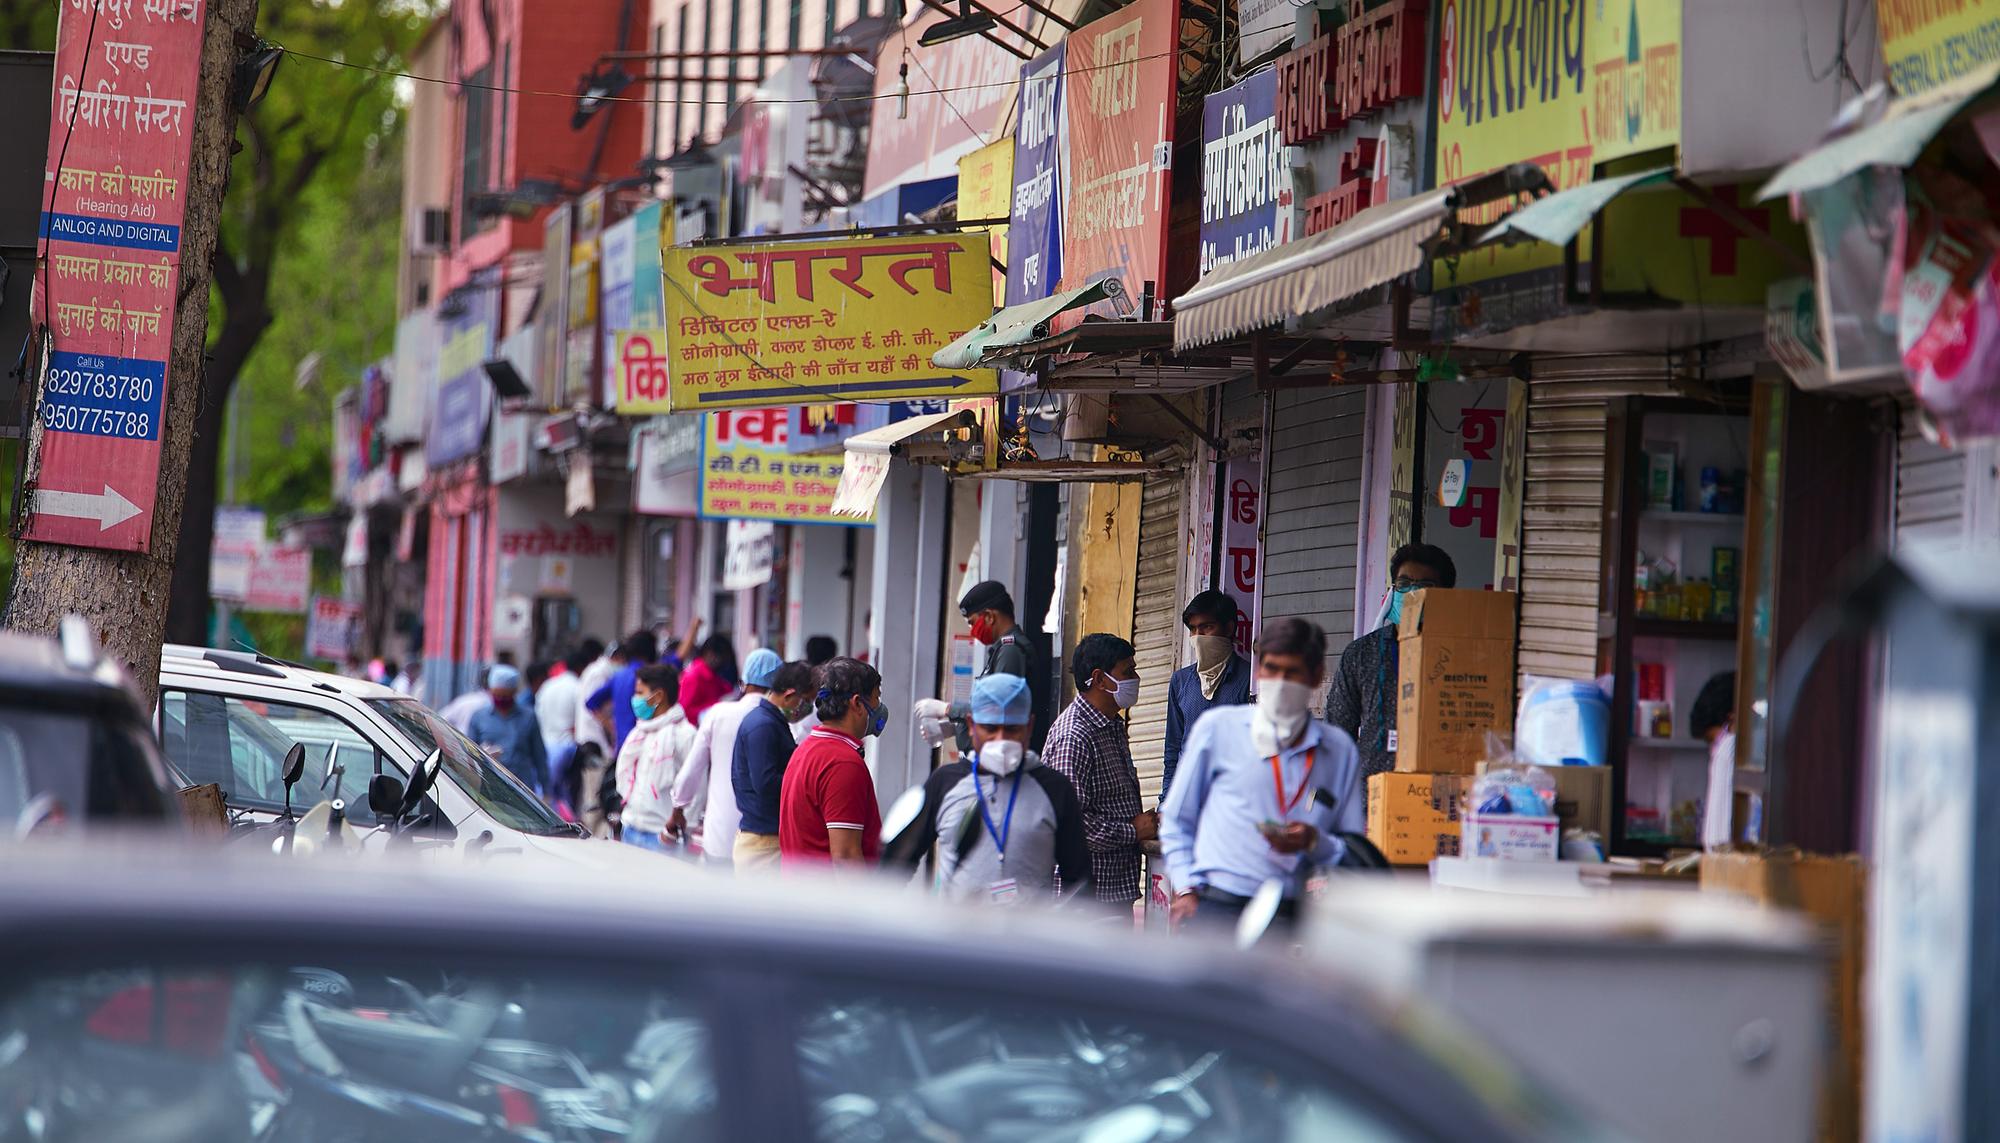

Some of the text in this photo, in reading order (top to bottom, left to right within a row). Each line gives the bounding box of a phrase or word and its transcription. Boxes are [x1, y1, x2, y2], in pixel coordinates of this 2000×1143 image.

[1089, 16, 1143, 121] भारत
[76, 196, 156, 219] (Hearing Aid)
[52, 217, 173, 243] ANLOG AND DIGITAL
[55, 254, 100, 282] समस्त
[148, 256, 172, 289] की
[687, 242, 965, 304] भारत
[56, 297, 98, 337] सुनाई
[679, 315, 759, 337] डिजिटल
[769, 340, 806, 354] कलर
[77, 356, 105, 368] Call Us
[801, 360, 822, 377] की
[901, 353, 922, 371] की
